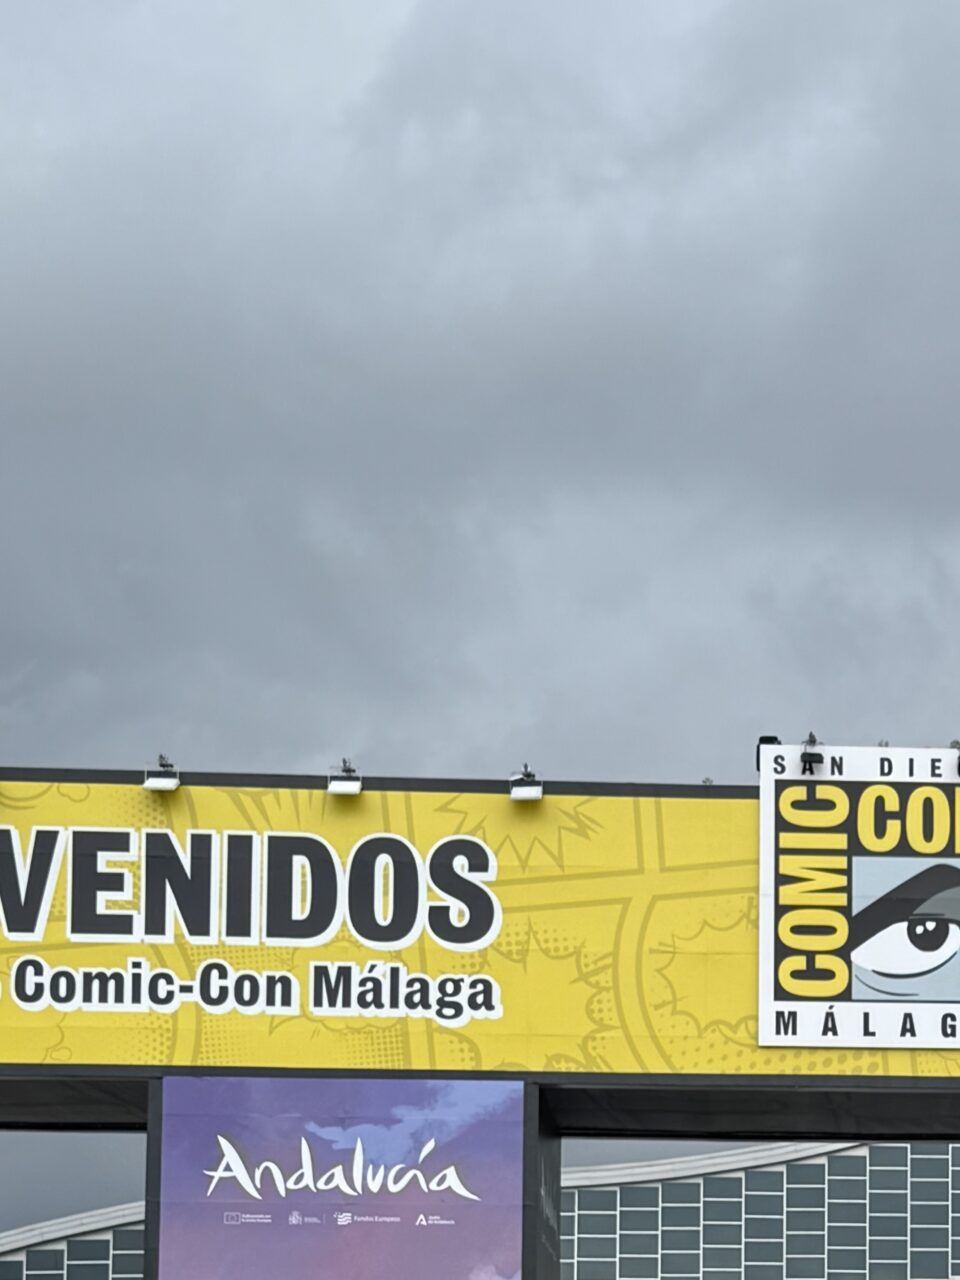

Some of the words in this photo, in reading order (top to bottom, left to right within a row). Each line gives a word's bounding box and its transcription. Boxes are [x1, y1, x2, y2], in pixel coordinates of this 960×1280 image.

[773, 755, 843, 776] SAN
[0, 829, 496, 943] VENIDOS
[778, 785, 849, 998] COMIC
[14, 958, 293, 1007] Comic-Con
[313, 963, 496, 1020] Málaga
[203, 1135, 482, 1201] Andalucía
